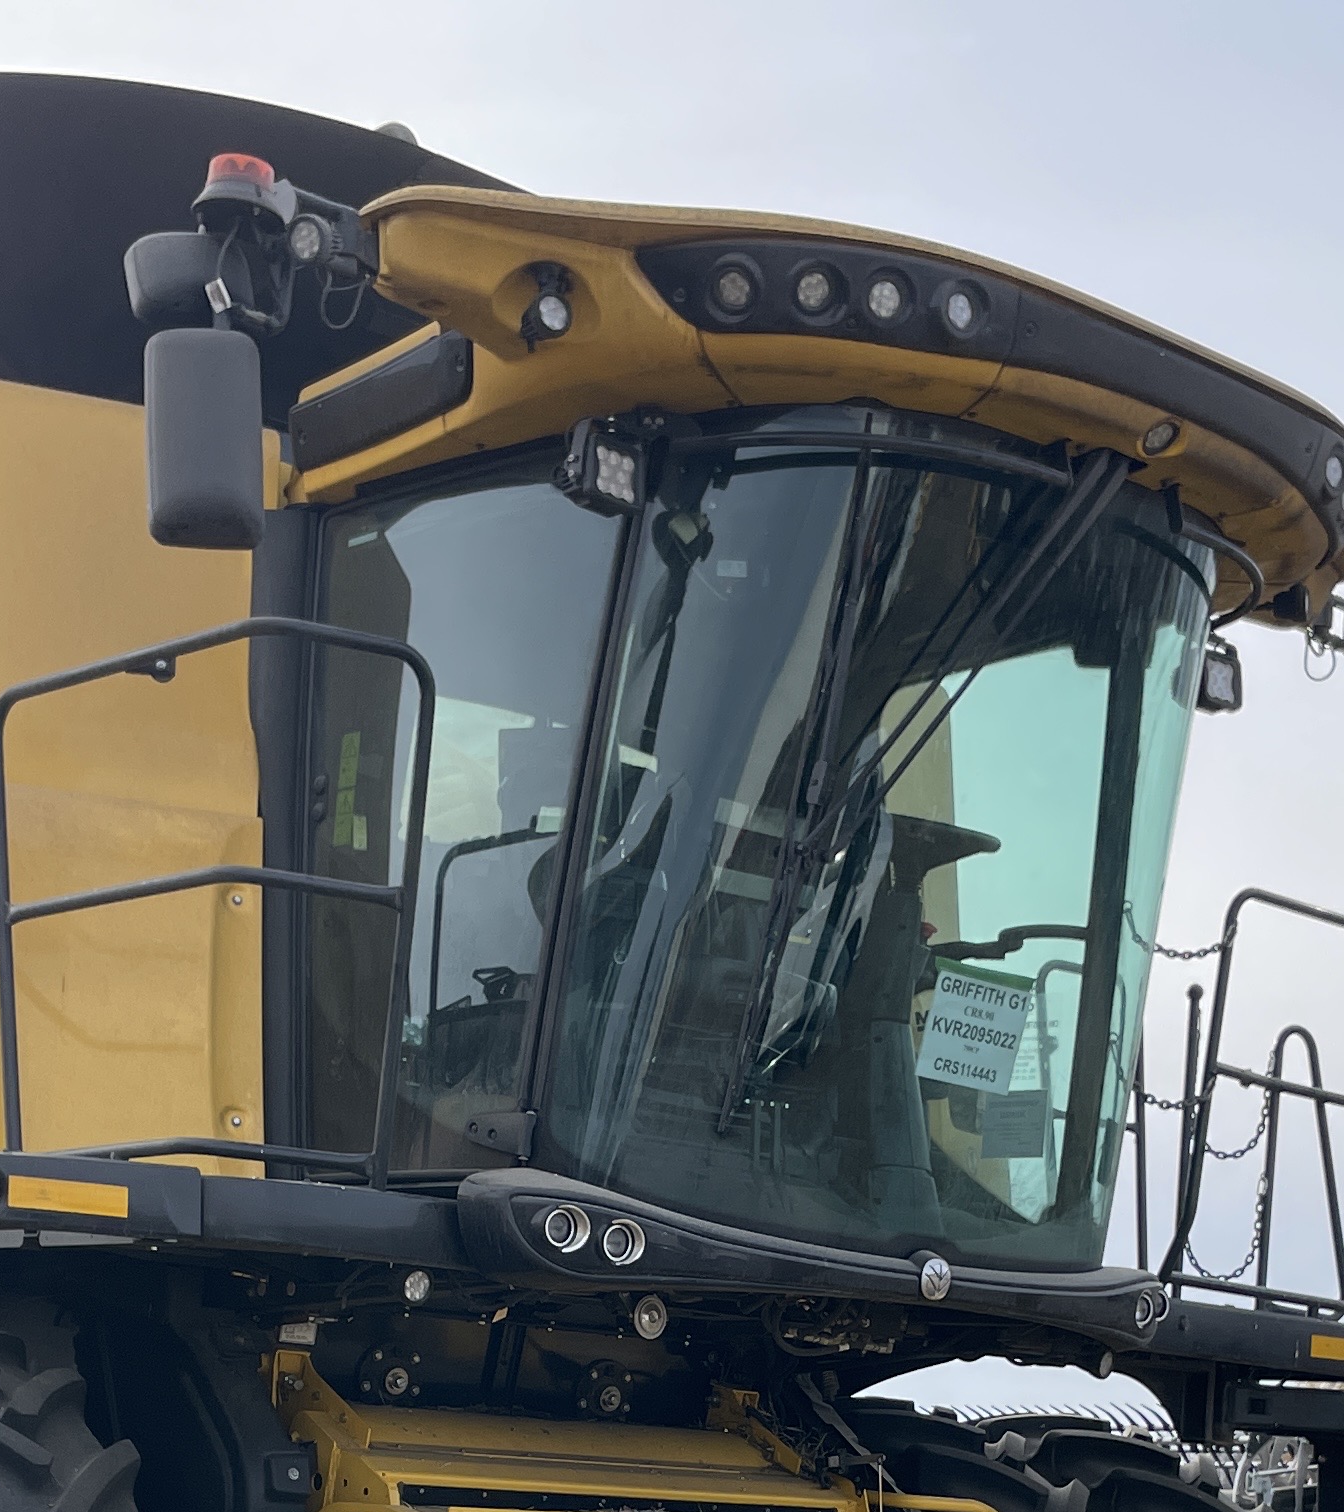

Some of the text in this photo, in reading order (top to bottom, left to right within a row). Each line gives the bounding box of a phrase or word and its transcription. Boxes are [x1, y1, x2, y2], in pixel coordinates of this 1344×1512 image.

[941, 976, 1007, 1007] GRIFFITH
[931, 1015, 1017, 1050] KVR2095022
[933, 1057, 998, 1083] CRS114443
